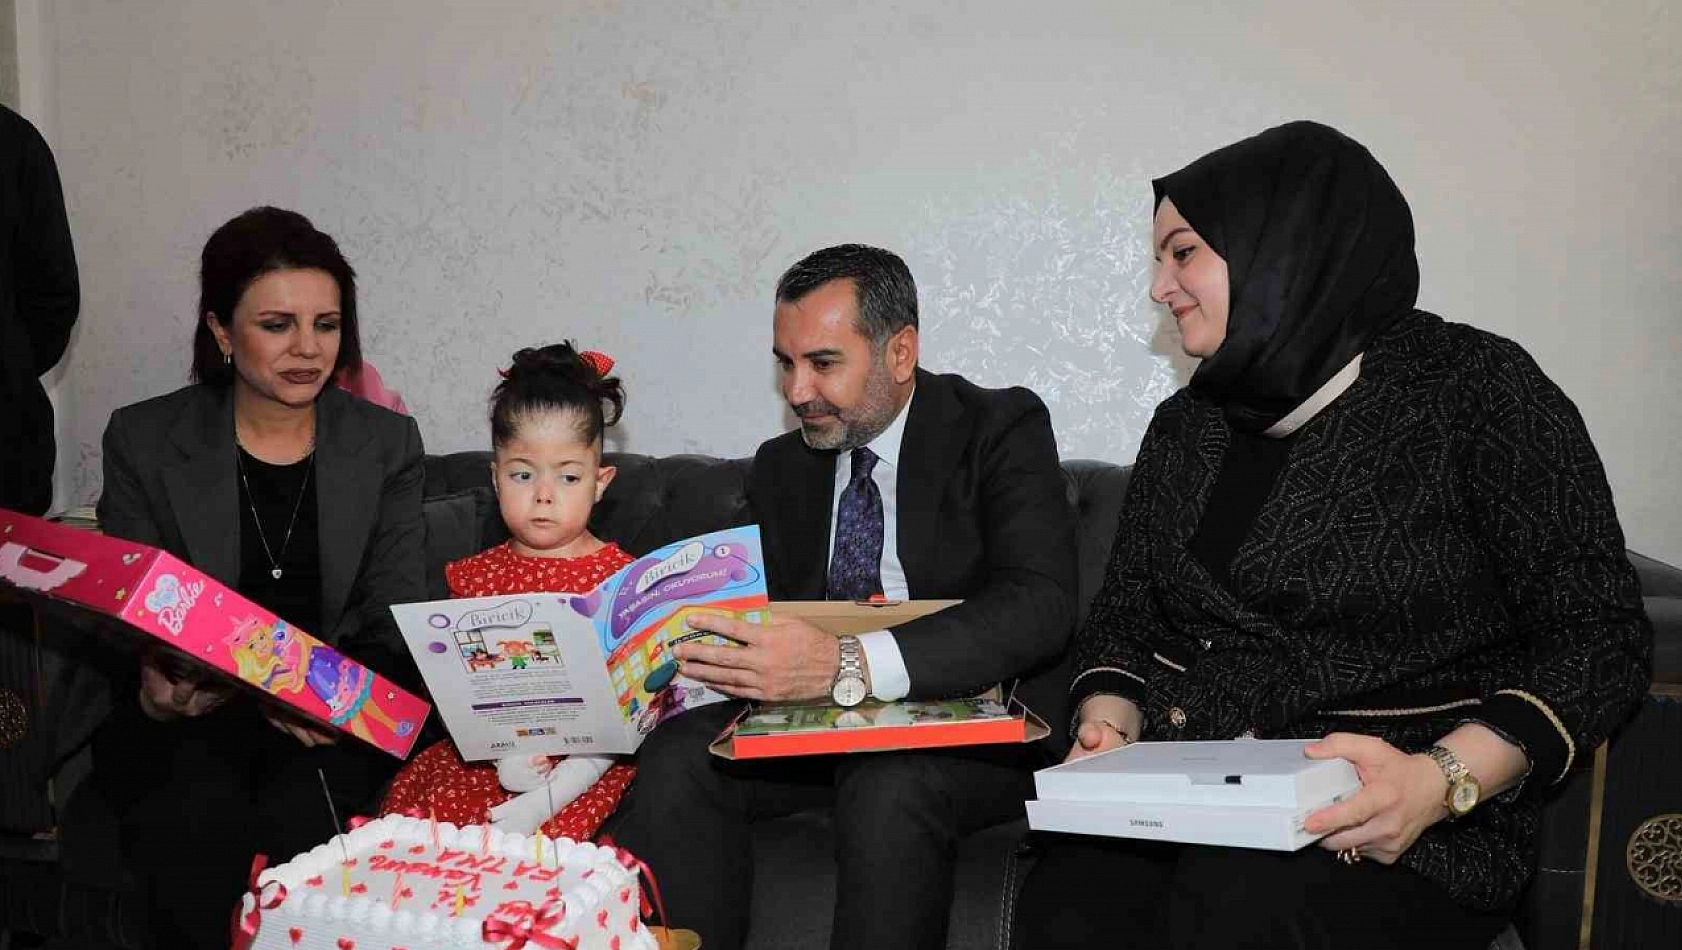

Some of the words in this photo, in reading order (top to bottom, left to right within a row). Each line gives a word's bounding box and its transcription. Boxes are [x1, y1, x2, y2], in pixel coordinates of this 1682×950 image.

[643, 552, 697, 586] Biricik
[157, 580, 204, 637] Barbie
[470, 603, 526, 627] Biricik
[1128, 819, 1164, 828] SAMSUNG
